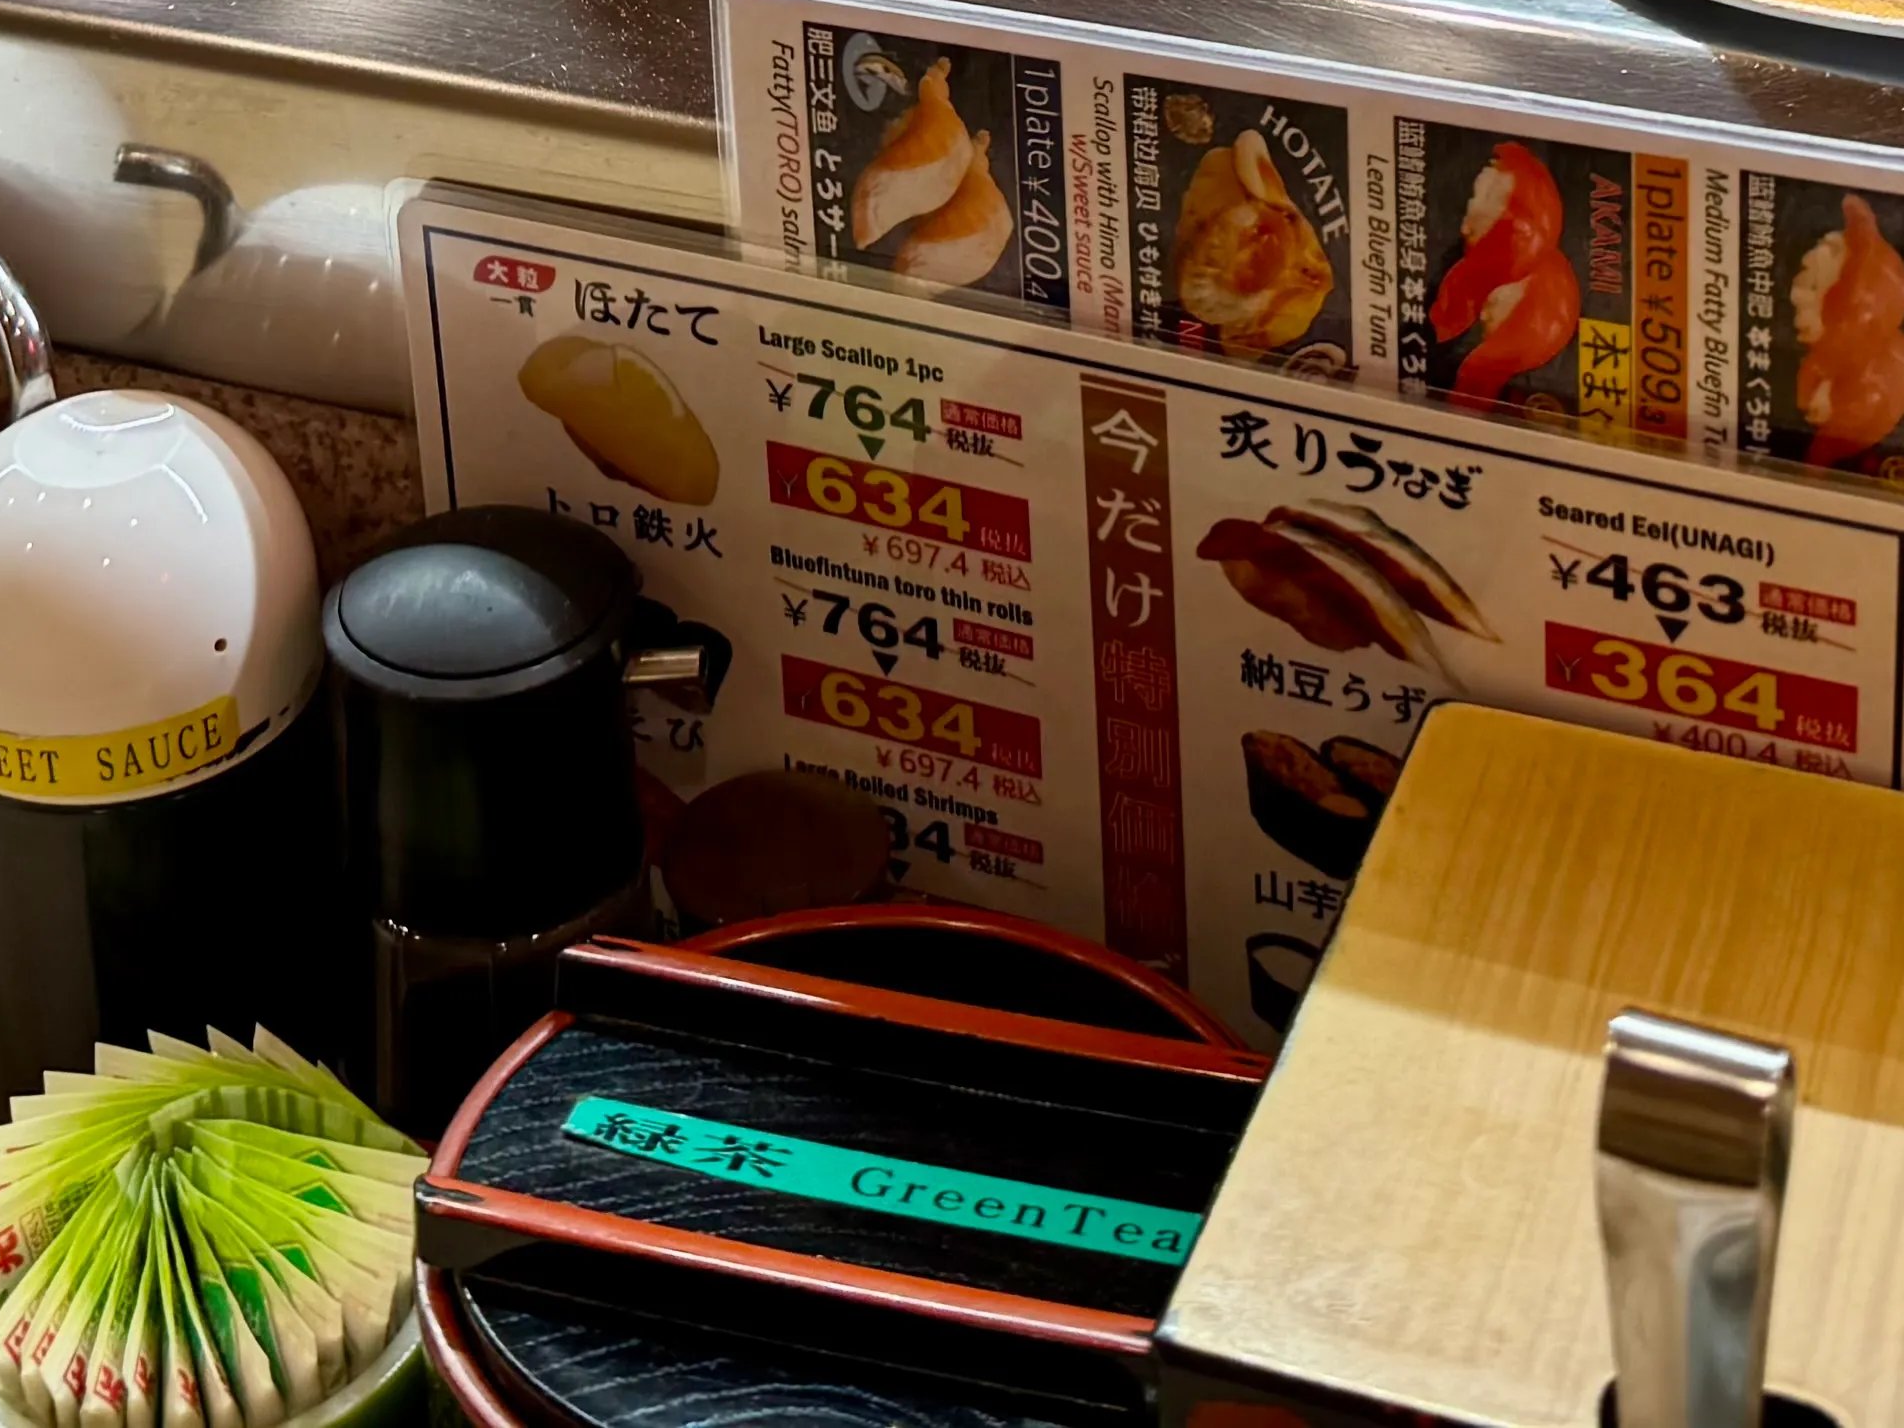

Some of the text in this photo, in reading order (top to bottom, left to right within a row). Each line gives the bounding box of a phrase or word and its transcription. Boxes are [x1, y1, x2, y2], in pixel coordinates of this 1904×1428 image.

[806, 26, 837, 134] 肥三文鱼
[1093, 77, 1119, 271] Scallop with Himo
[1260, 105, 1350, 244] HOTATE
[1069, 133, 1093, 295] w/Sweet sauce
[1589, 172, 1622, 295] AKAMI
[486, 260, 542, 289] 大粒
[1362, 153, 1393, 359] Lean Bluefin Tuna
[490, 295, 538, 319] 一貫
[573, 278, 720, 347] ほたて
[1696, 168, 1729, 418] Medium Fatty Bluefin
[758, 324, 945, 384] Large Scallop 1pc
[765, 373, 933, 444] ¥764
[1218, 409, 1483, 511] 炙りうなぎ
[545, 486, 724, 559] トロ鉄火
[1538, 496, 1775, 569] Seared Eel(UNAGI)
[781, 588, 946, 661] ¥764
[894, 576, 936, 604] toro
[941, 589, 982, 613] thin
[987, 601, 1034, 627] rolls
[1549, 553, 1746, 625] ¥463
[97, 713, 222, 783] SAUCE
[845, 769, 999, 826] Boiled Shrimps
[596, 1112, 794, 1179] 緑茶
